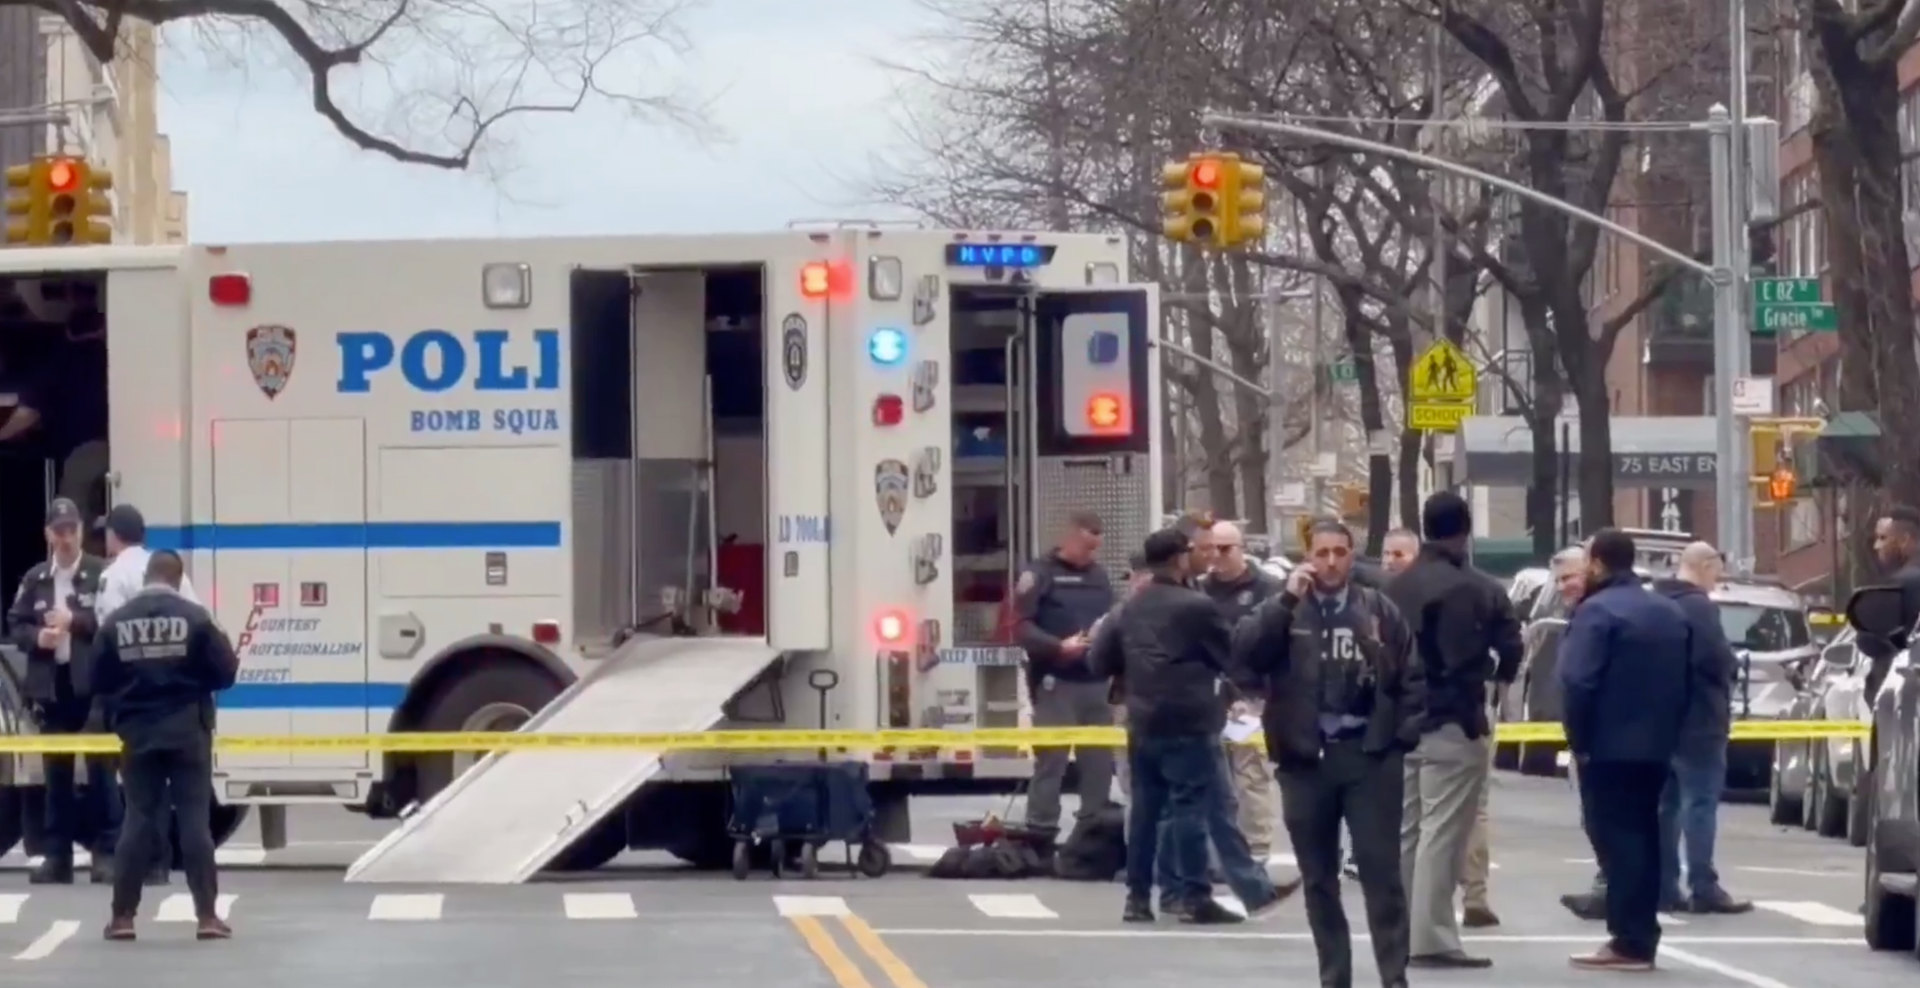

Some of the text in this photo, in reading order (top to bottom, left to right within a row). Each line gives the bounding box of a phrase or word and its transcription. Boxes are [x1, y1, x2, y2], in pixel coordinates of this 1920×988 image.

[961, 246, 1034, 263] NYPD
[1763, 281, 1773, 301] E
[1777, 281, 1794, 301] 82
[1764, 307, 1807, 327] Gracie
[410, 410, 481, 431] BOMB
[1621, 457, 1642, 473] 75
[1649, 456, 1691, 473] EAST
[116, 617, 188, 647] NYPD
[236, 632, 362, 657] PROFESSIONALISM
[239, 668, 291, 681] ESPECT
